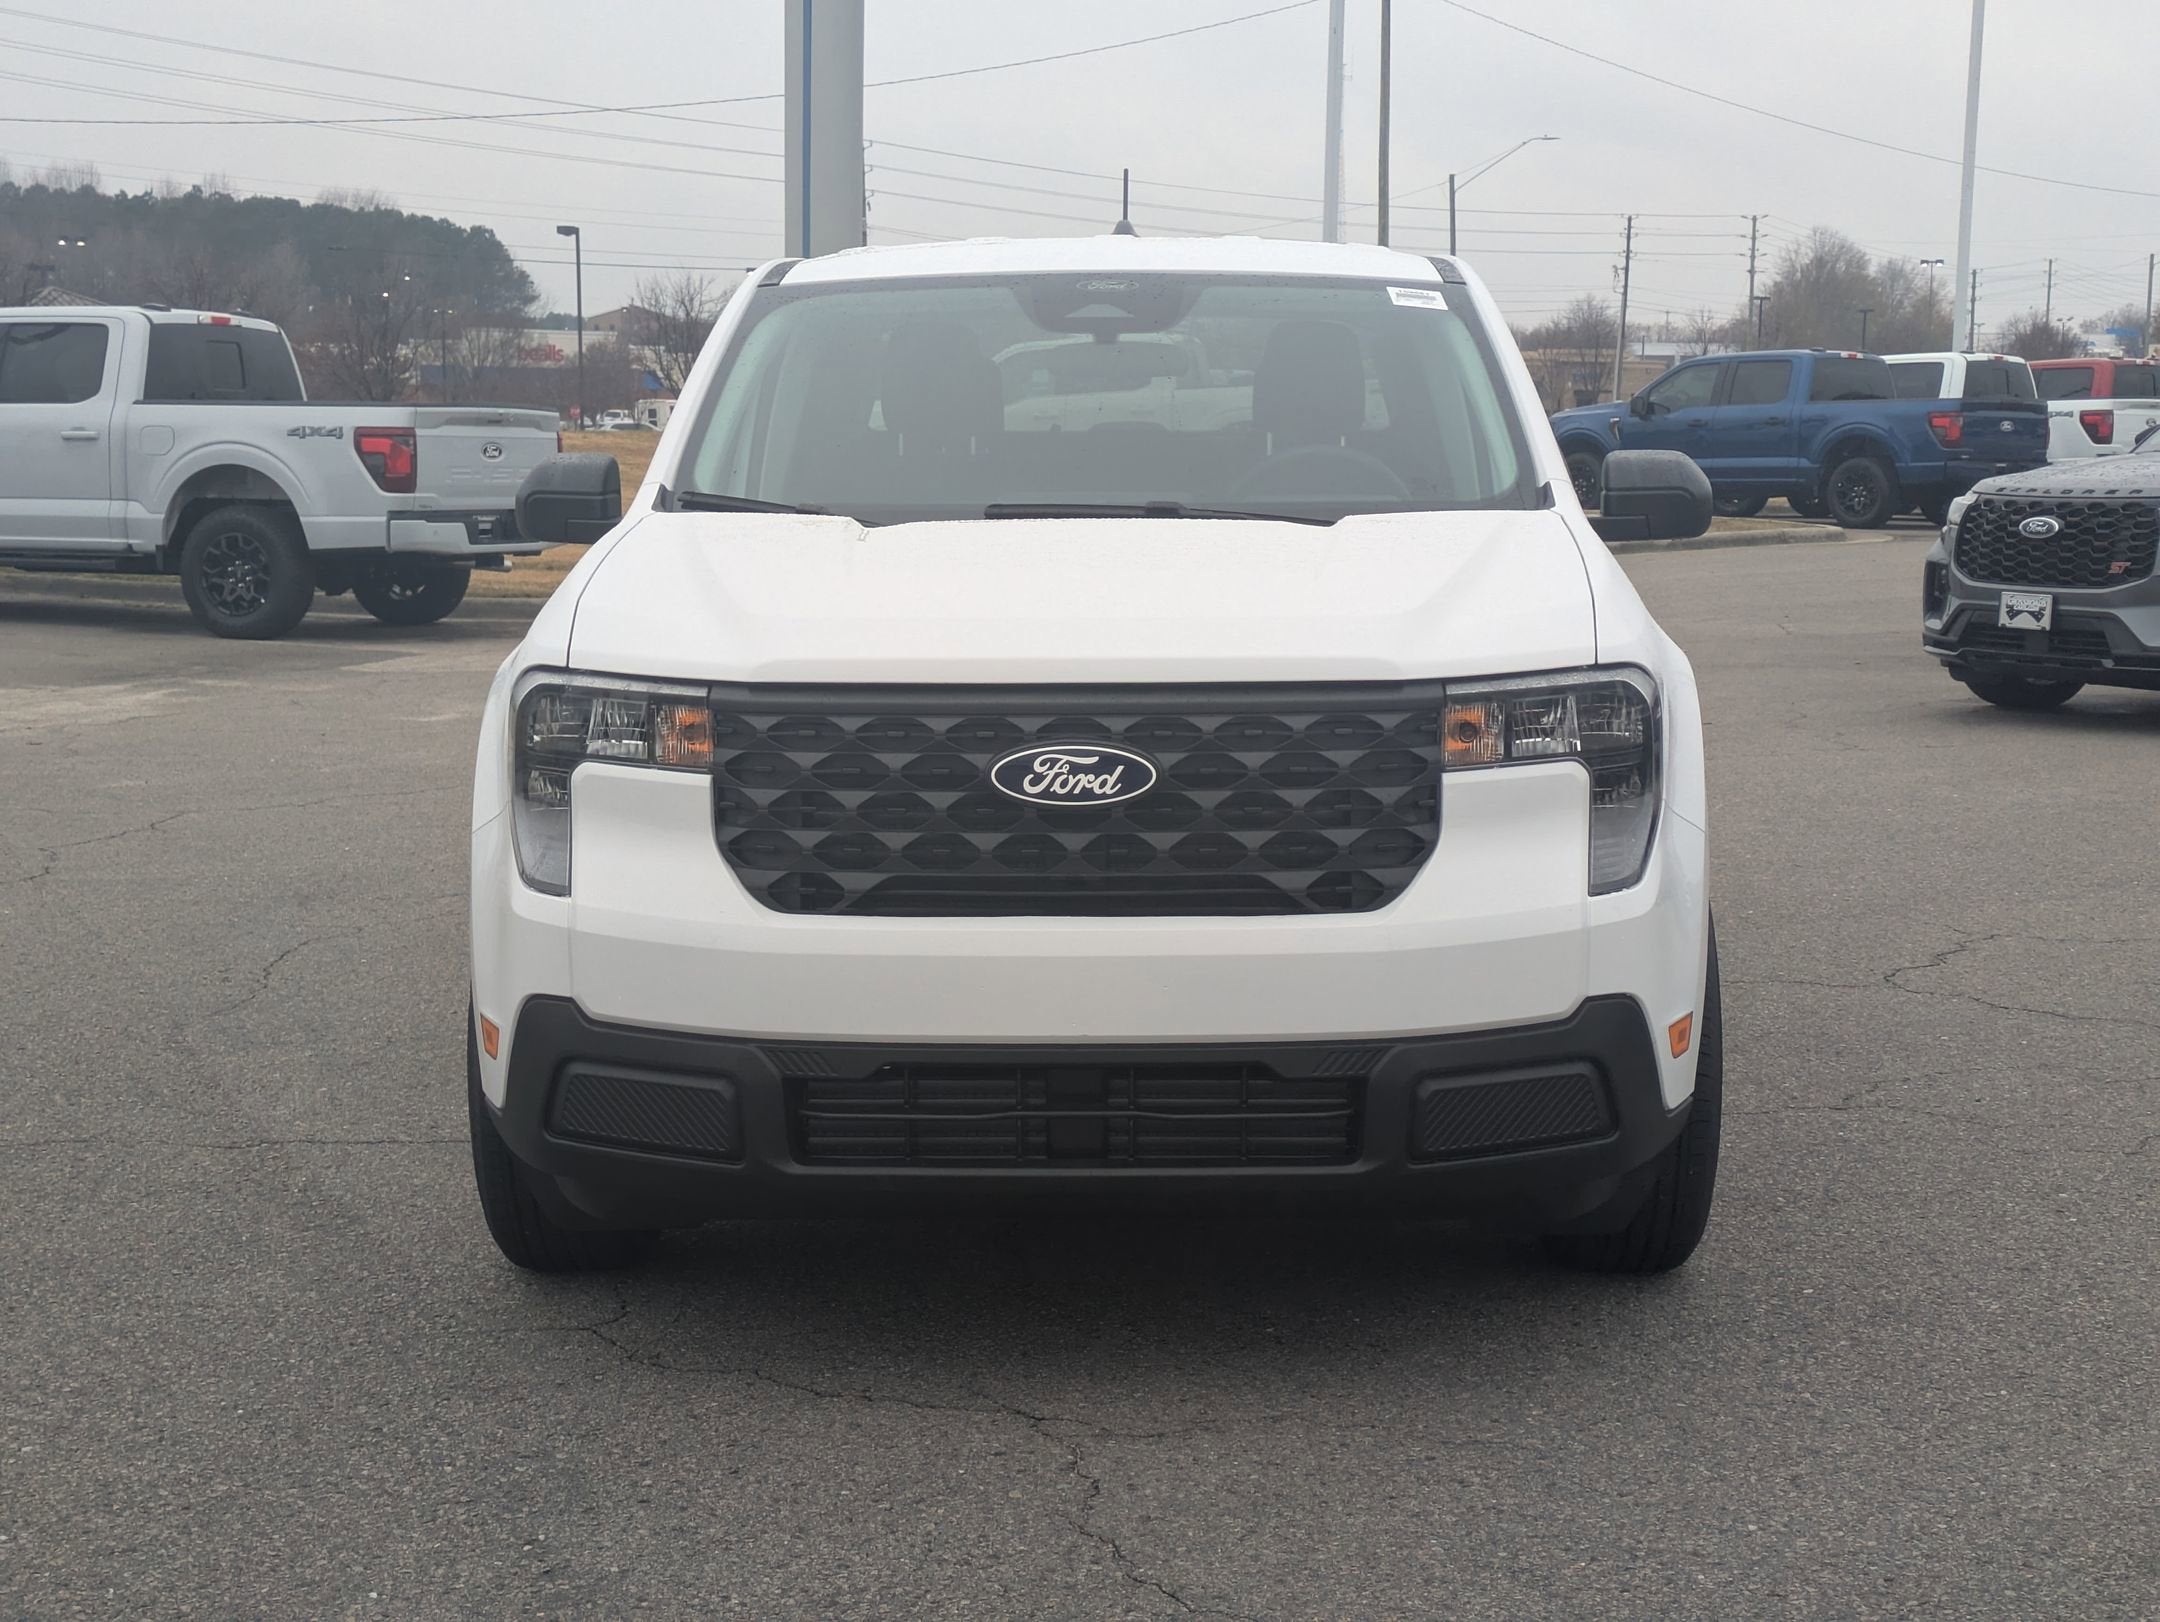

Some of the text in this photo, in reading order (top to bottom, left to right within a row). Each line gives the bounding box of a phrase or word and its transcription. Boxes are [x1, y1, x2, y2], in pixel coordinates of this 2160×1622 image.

[1995, 487, 2144, 495] EXPLORER
[2026, 521, 2049, 533] Ford
[2108, 561, 2132, 574] ST
[1023, 754, 1125, 795] Ford
